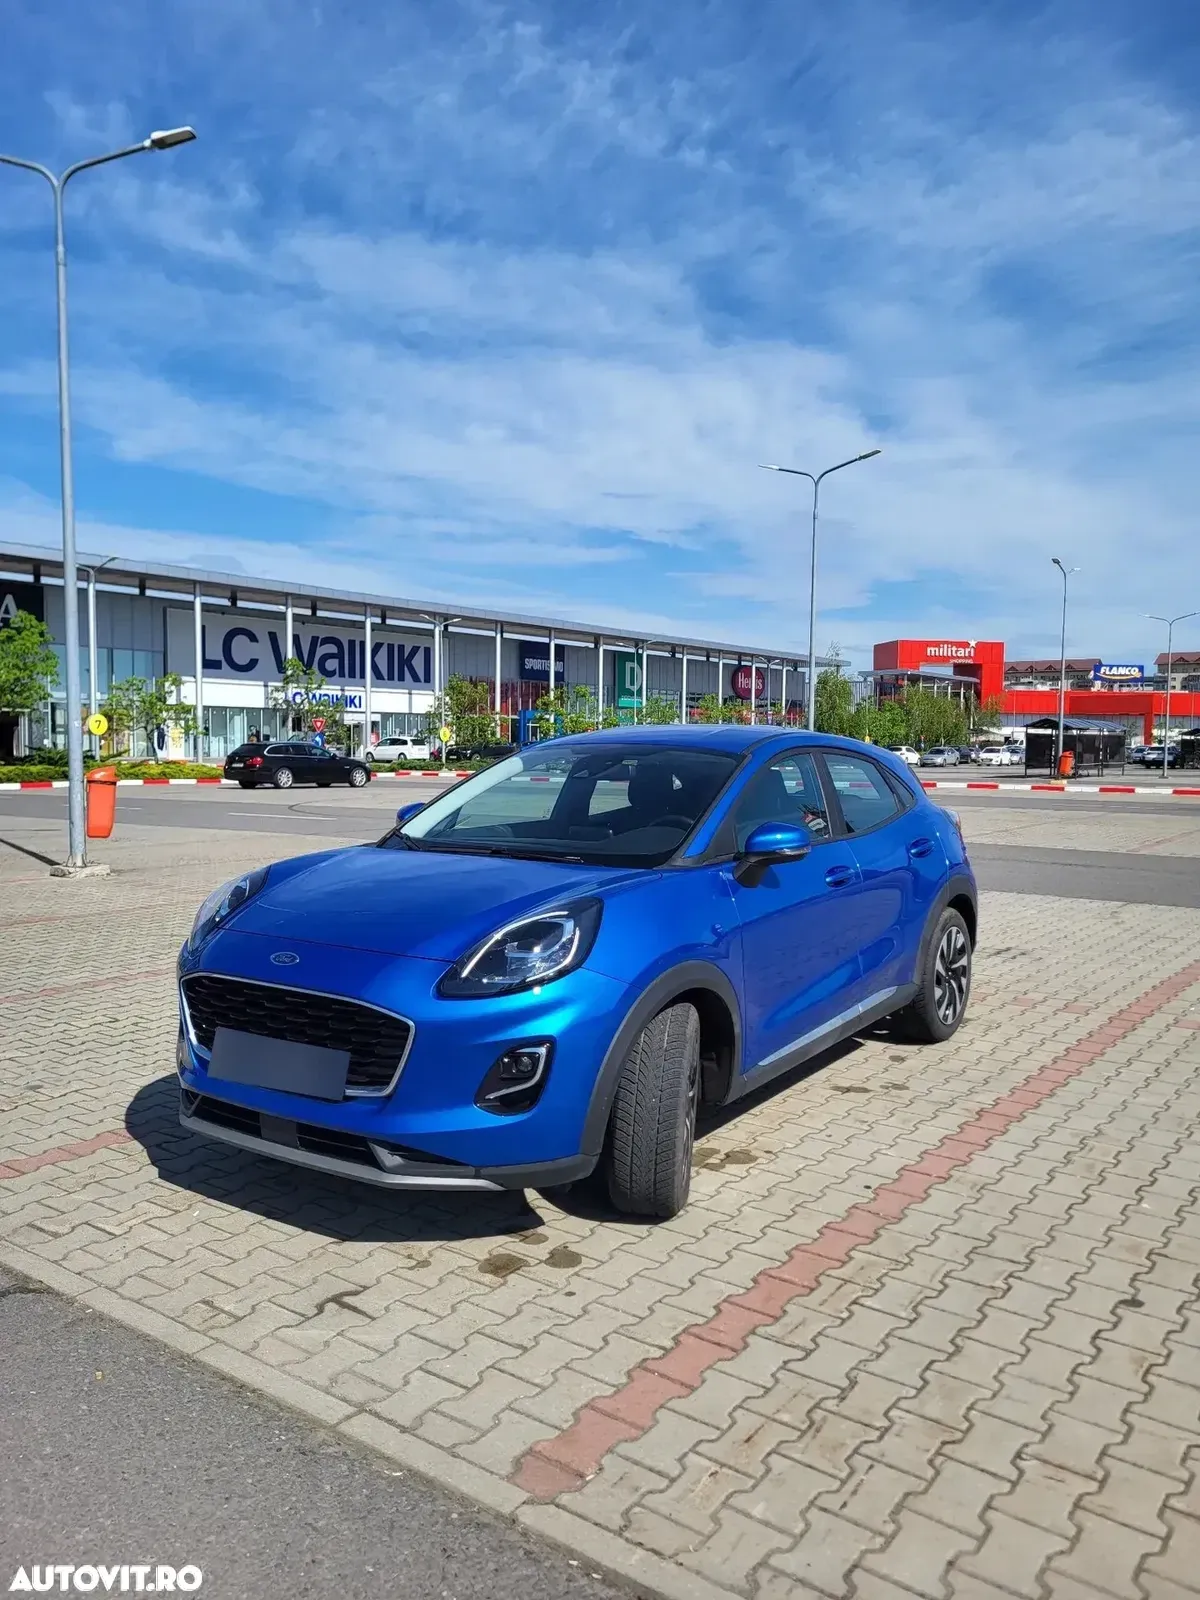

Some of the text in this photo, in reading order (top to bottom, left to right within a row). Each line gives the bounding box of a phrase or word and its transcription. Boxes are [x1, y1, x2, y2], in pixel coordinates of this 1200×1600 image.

[201, 624, 259, 673] LC
[926, 644, 974, 657] militari
[525, 658, 563, 672] SPORTISMO
[1100, 666, 1139, 675] FLANCO
[738, 672, 763, 690] Heris
[95, 719, 102, 730] 7
